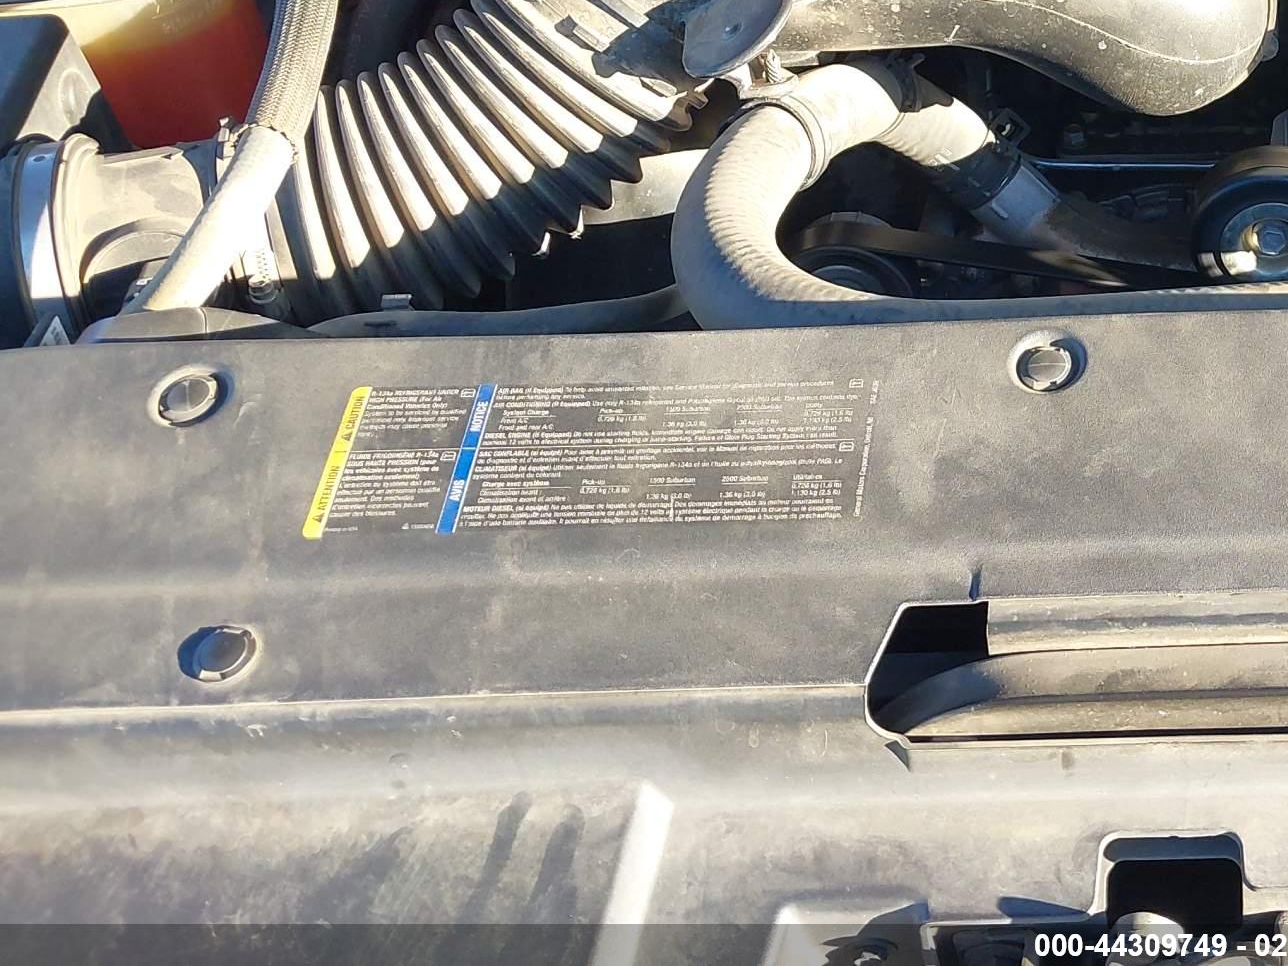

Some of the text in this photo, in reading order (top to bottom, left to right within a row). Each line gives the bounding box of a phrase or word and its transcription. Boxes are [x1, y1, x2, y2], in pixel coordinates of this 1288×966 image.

[346, 396, 365, 431] CAUTION
[470, 401, 489, 431] NOTICE
[318, 465, 340, 511] ATTENTION
[449, 479, 465, 501] AVIS
[855, 476, 866, 495] Motors
